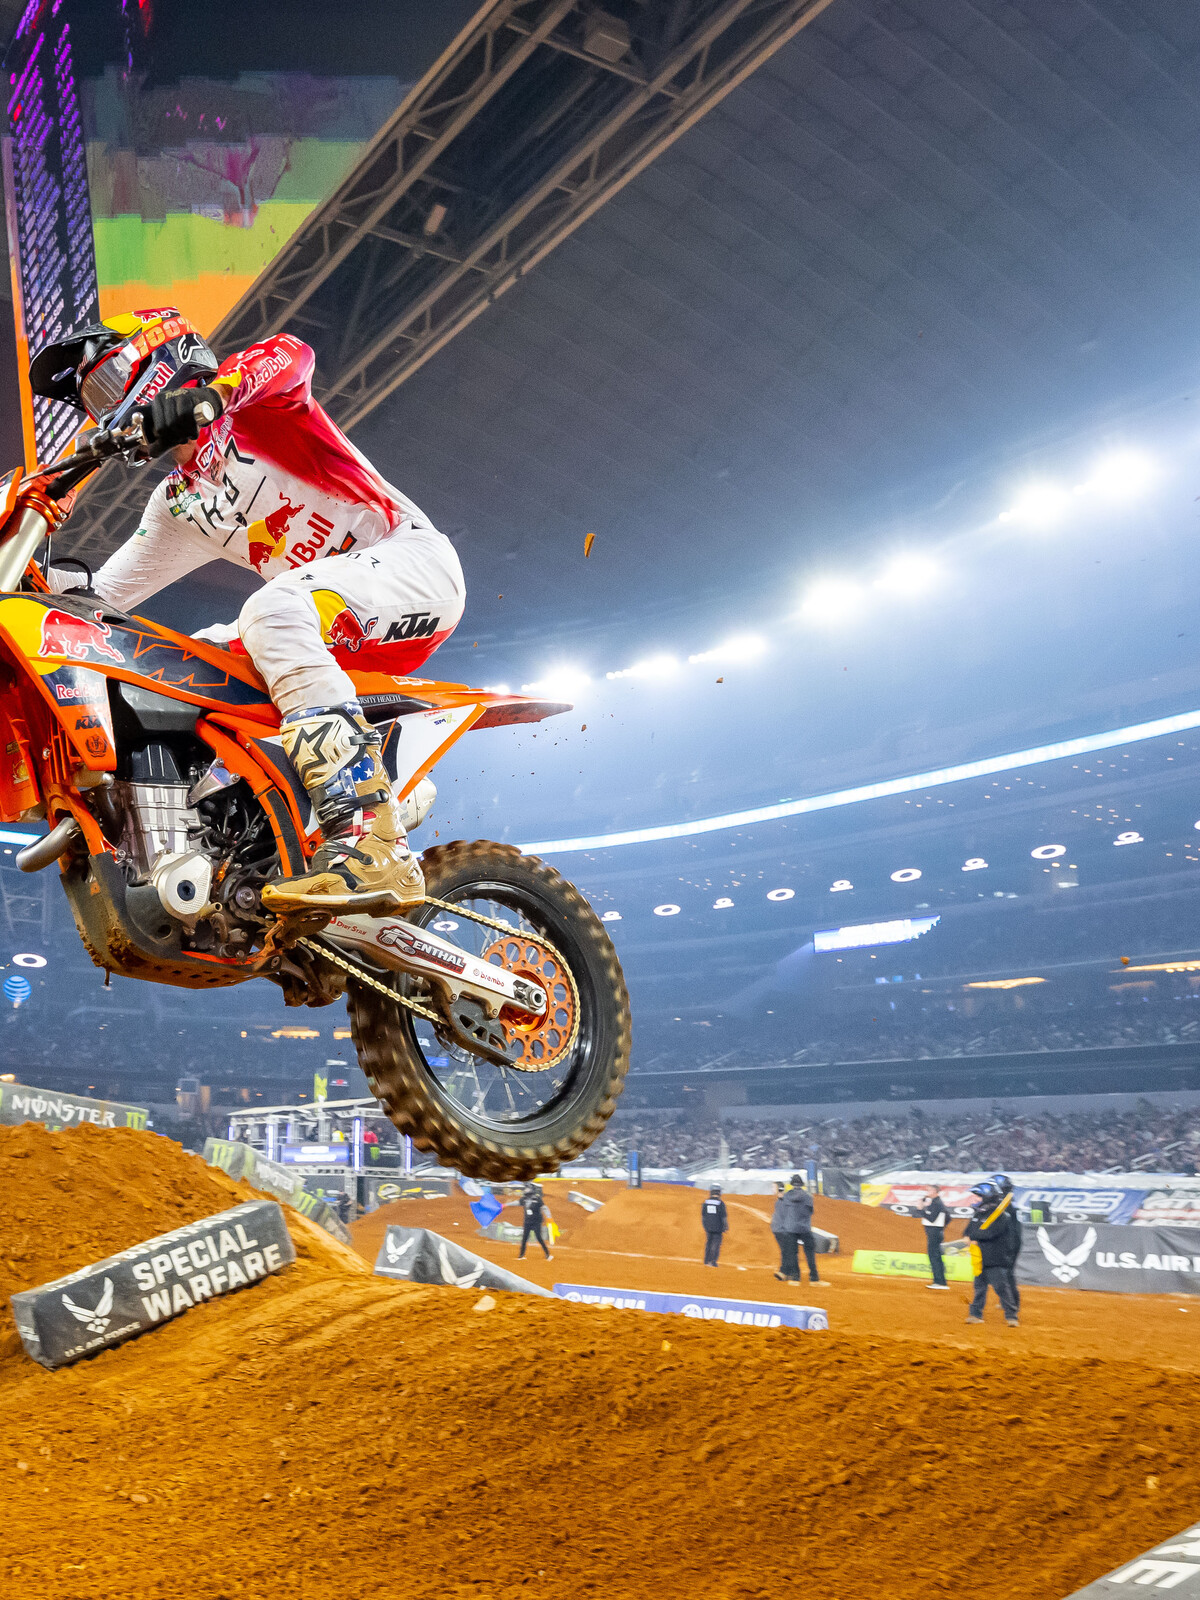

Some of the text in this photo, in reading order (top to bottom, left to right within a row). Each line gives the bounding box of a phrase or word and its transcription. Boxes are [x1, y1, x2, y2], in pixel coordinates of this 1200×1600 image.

[135, 316, 199, 358] 100%
[381, 612, 440, 643] KTM
[11, 1094, 117, 1129] MONSTER
[132, 1224, 259, 1292] SPECIAL
[1142, 1253, 1191, 1272] AIR
[140, 1243, 284, 1323] WARFARE
